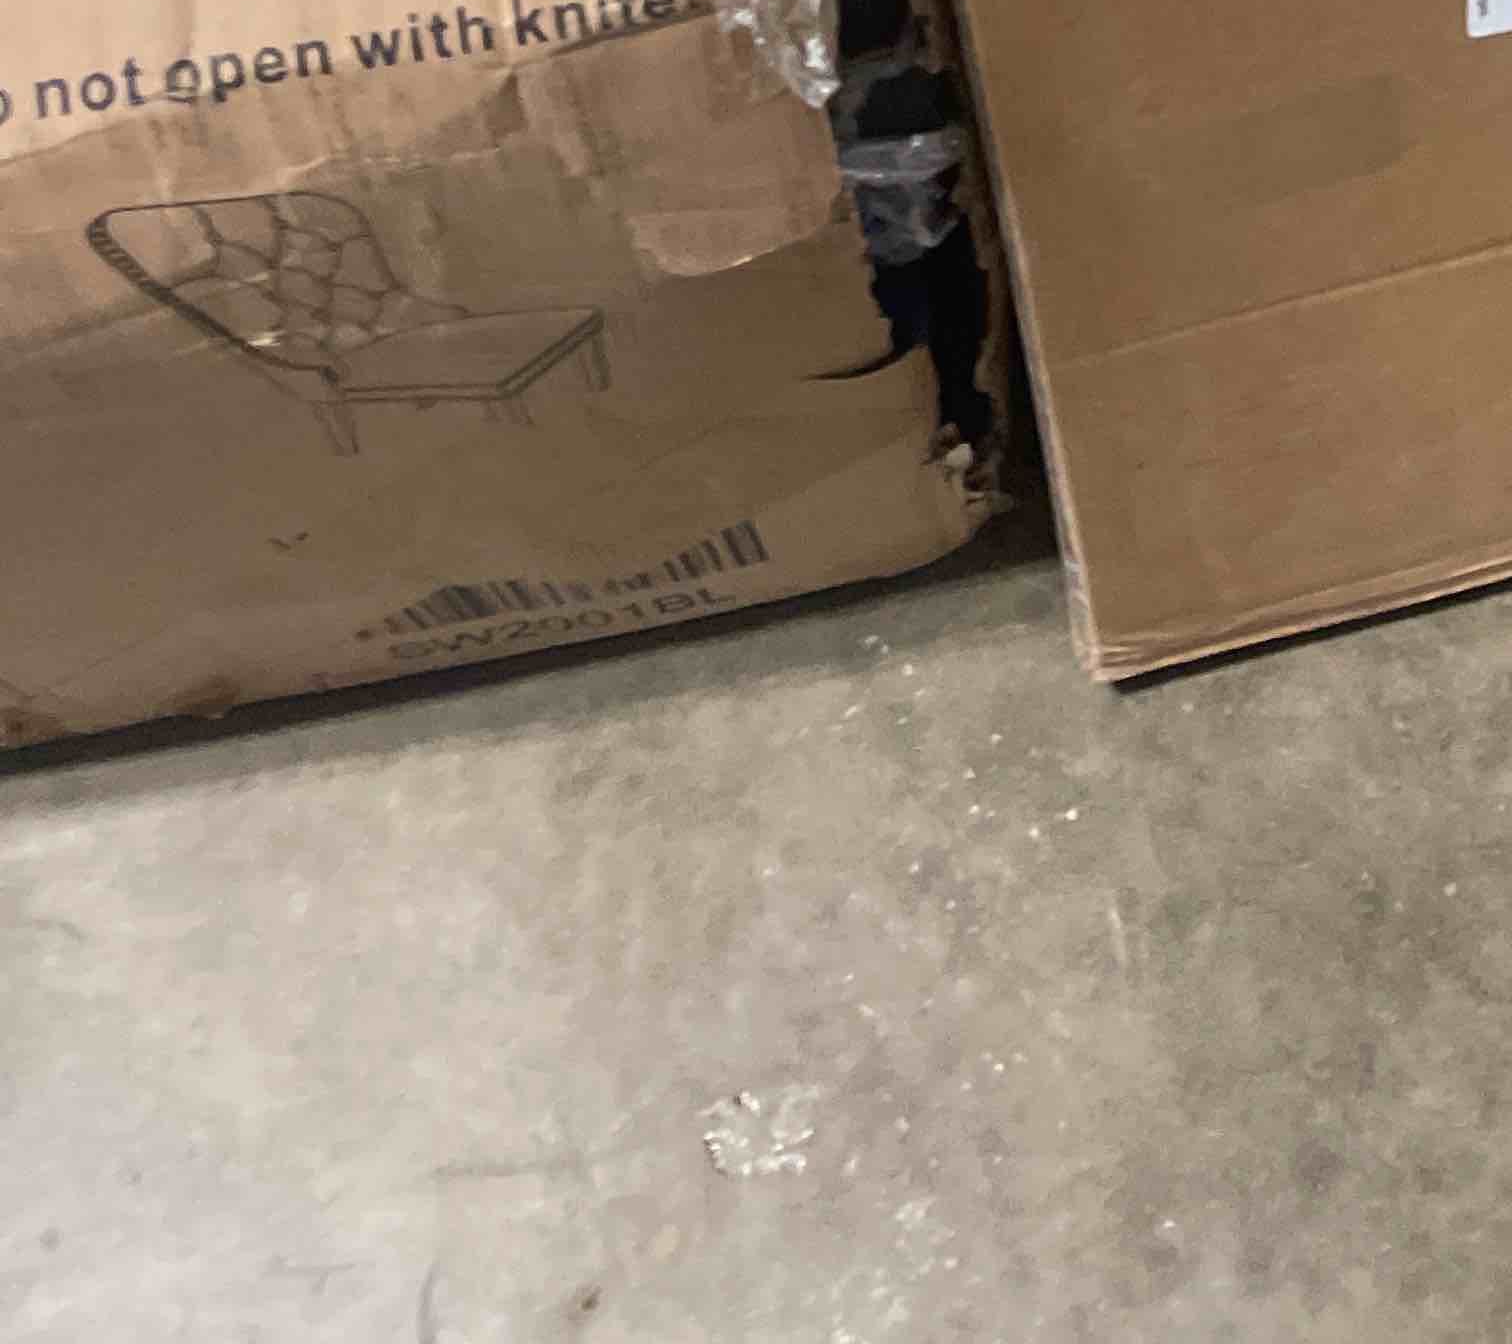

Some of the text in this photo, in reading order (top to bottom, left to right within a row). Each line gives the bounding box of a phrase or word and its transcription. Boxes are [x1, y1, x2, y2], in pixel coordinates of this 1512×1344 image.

[35, 57, 147, 119] not
[163, 39, 333, 106] open
[349, 5, 496, 71] with
